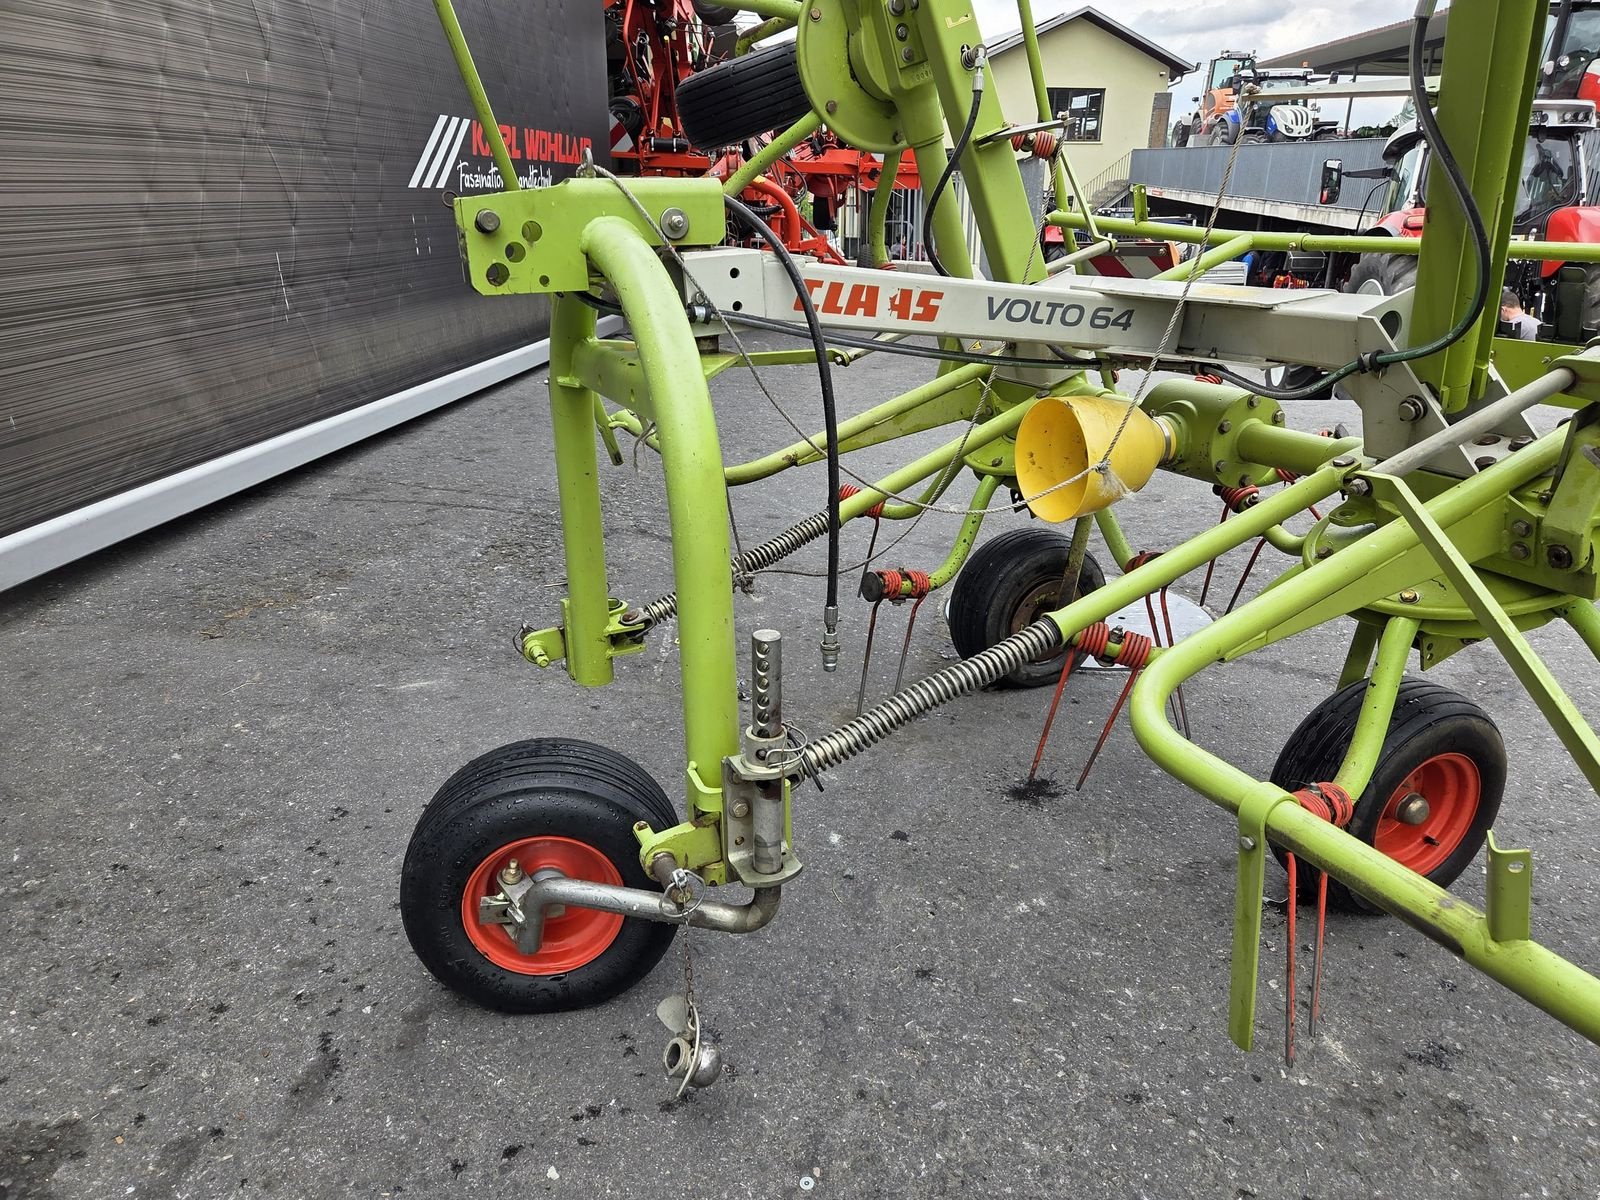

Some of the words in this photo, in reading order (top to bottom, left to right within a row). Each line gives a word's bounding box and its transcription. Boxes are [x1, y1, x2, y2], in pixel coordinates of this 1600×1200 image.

[472, 119, 521, 159] KRL
[518, 164, 553, 189] andtechnik
[793, 278, 945, 323] CLAAS
[987, 296, 1086, 327] VOLTO
[1089, 306, 1135, 331] 64
